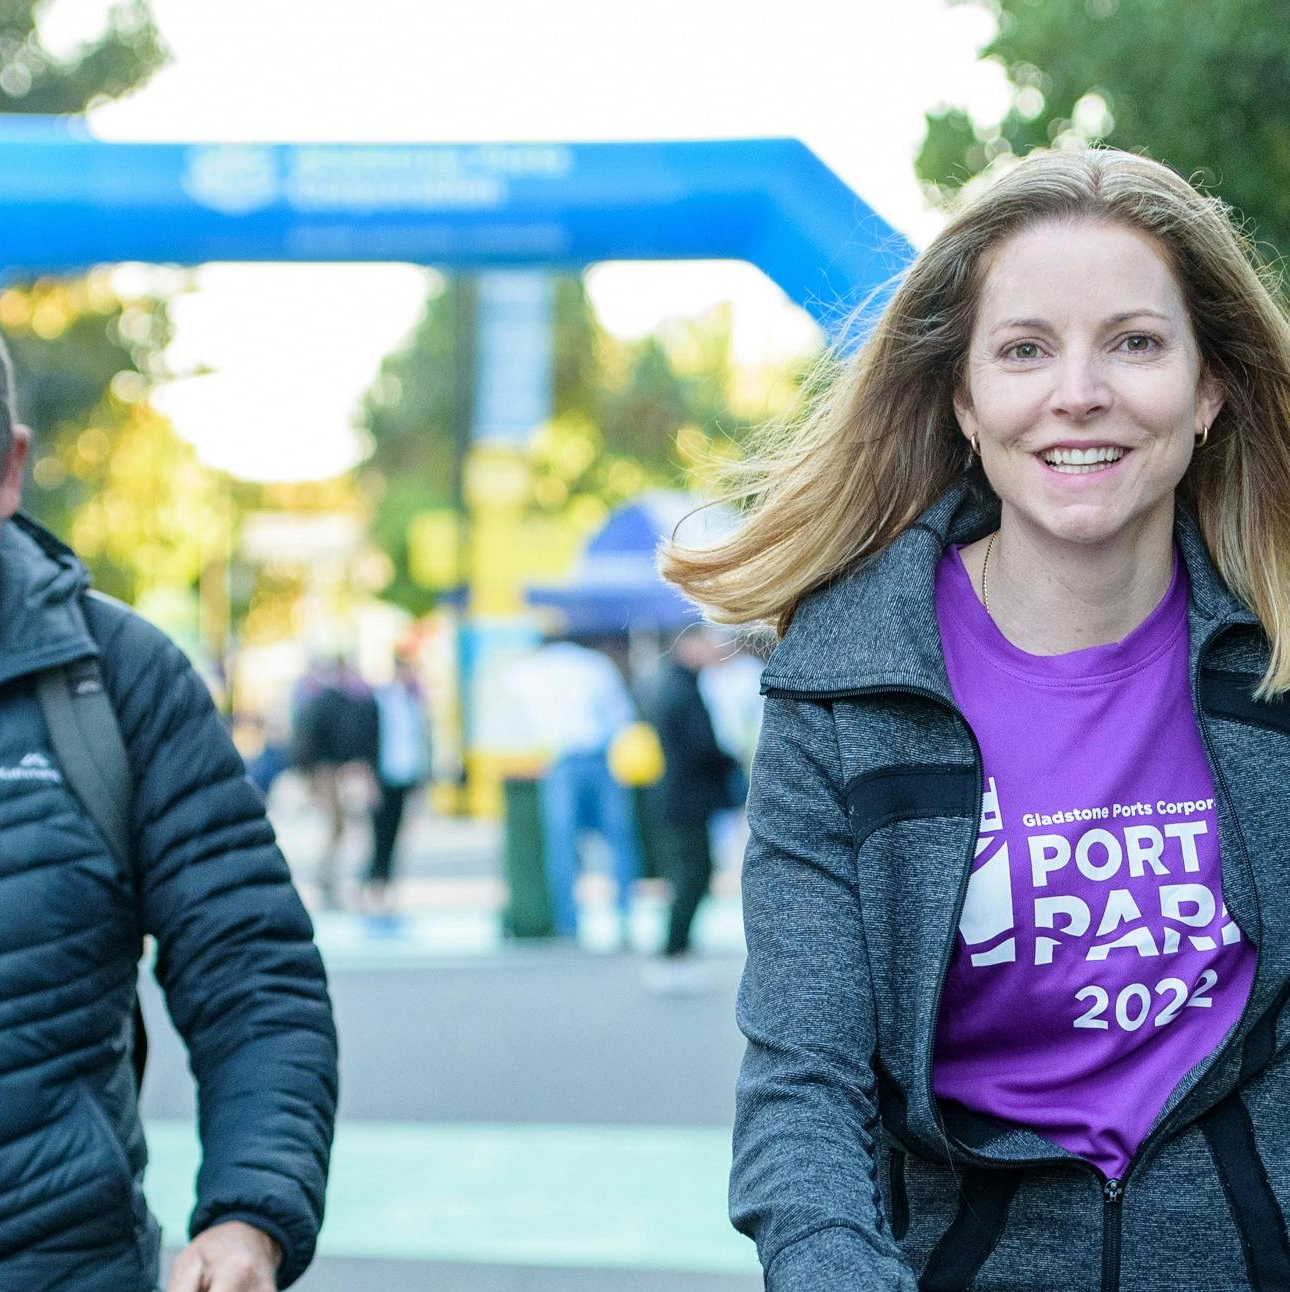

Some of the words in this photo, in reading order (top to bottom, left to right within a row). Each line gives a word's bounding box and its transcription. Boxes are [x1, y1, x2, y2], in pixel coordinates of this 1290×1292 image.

[1022, 804, 1110, 828] Gladstone
[1112, 801, 1153, 818] Ports
[1156, 797, 1217, 817] Corpor
[1027, 820, 1208, 888] PORT
[1073, 969, 1219, 1032] 2022
